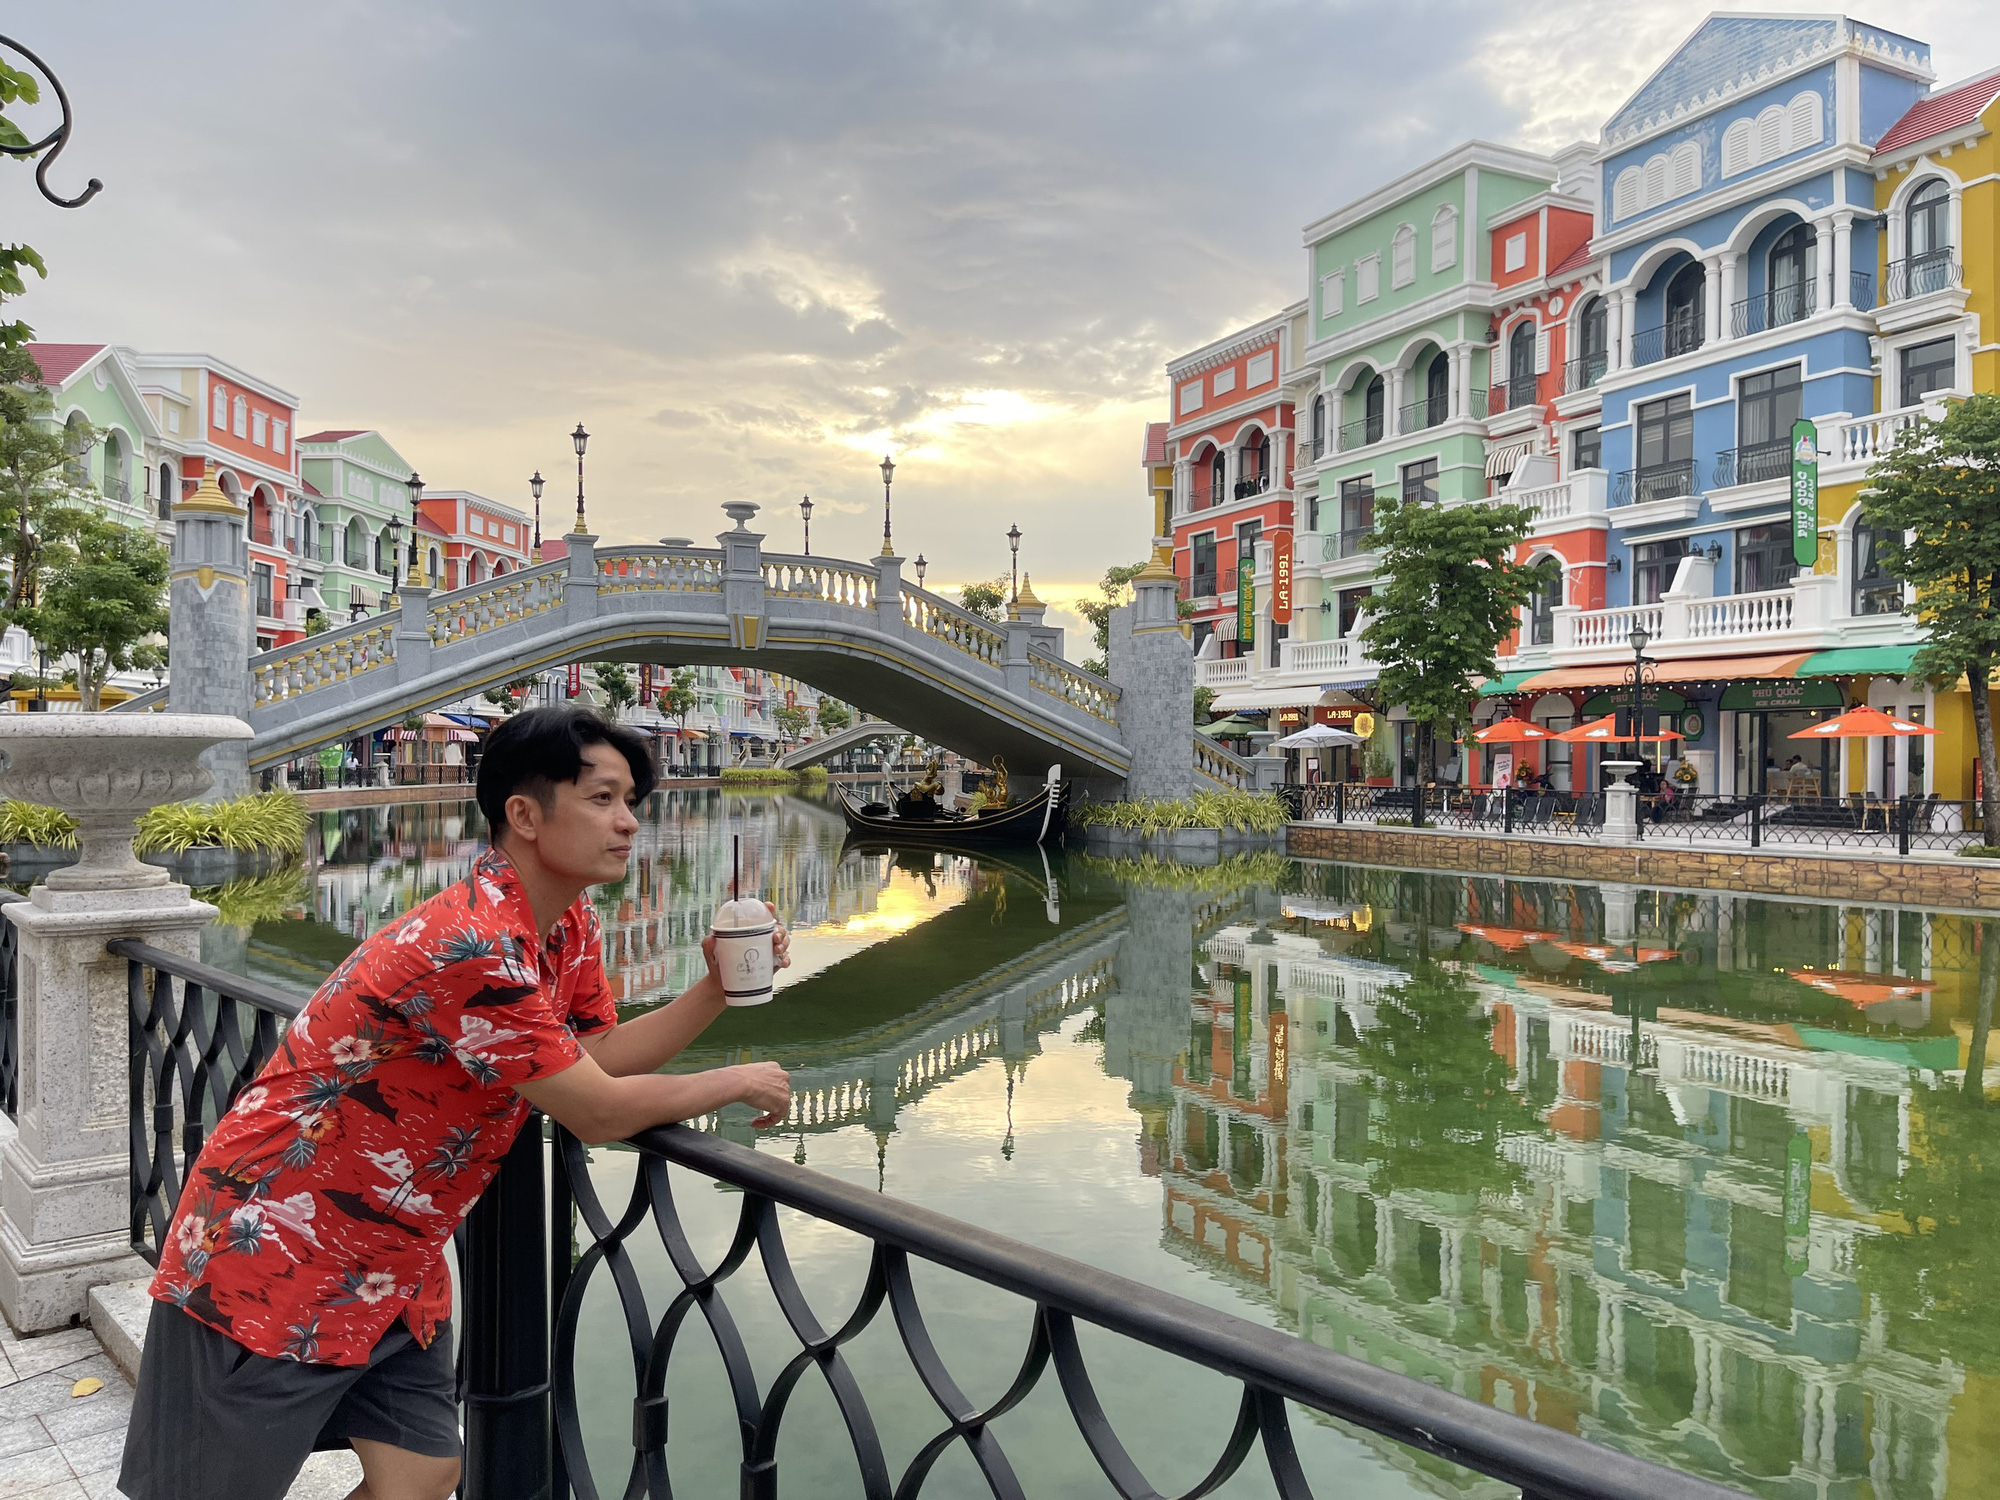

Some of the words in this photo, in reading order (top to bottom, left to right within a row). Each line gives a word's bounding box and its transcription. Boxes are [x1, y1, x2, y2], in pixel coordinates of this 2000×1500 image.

[1278, 553, 1289, 610] LA-1991
[1752, 686, 1772, 698] PHÚ
[1327, 709, 1352, 719] LA-1991
